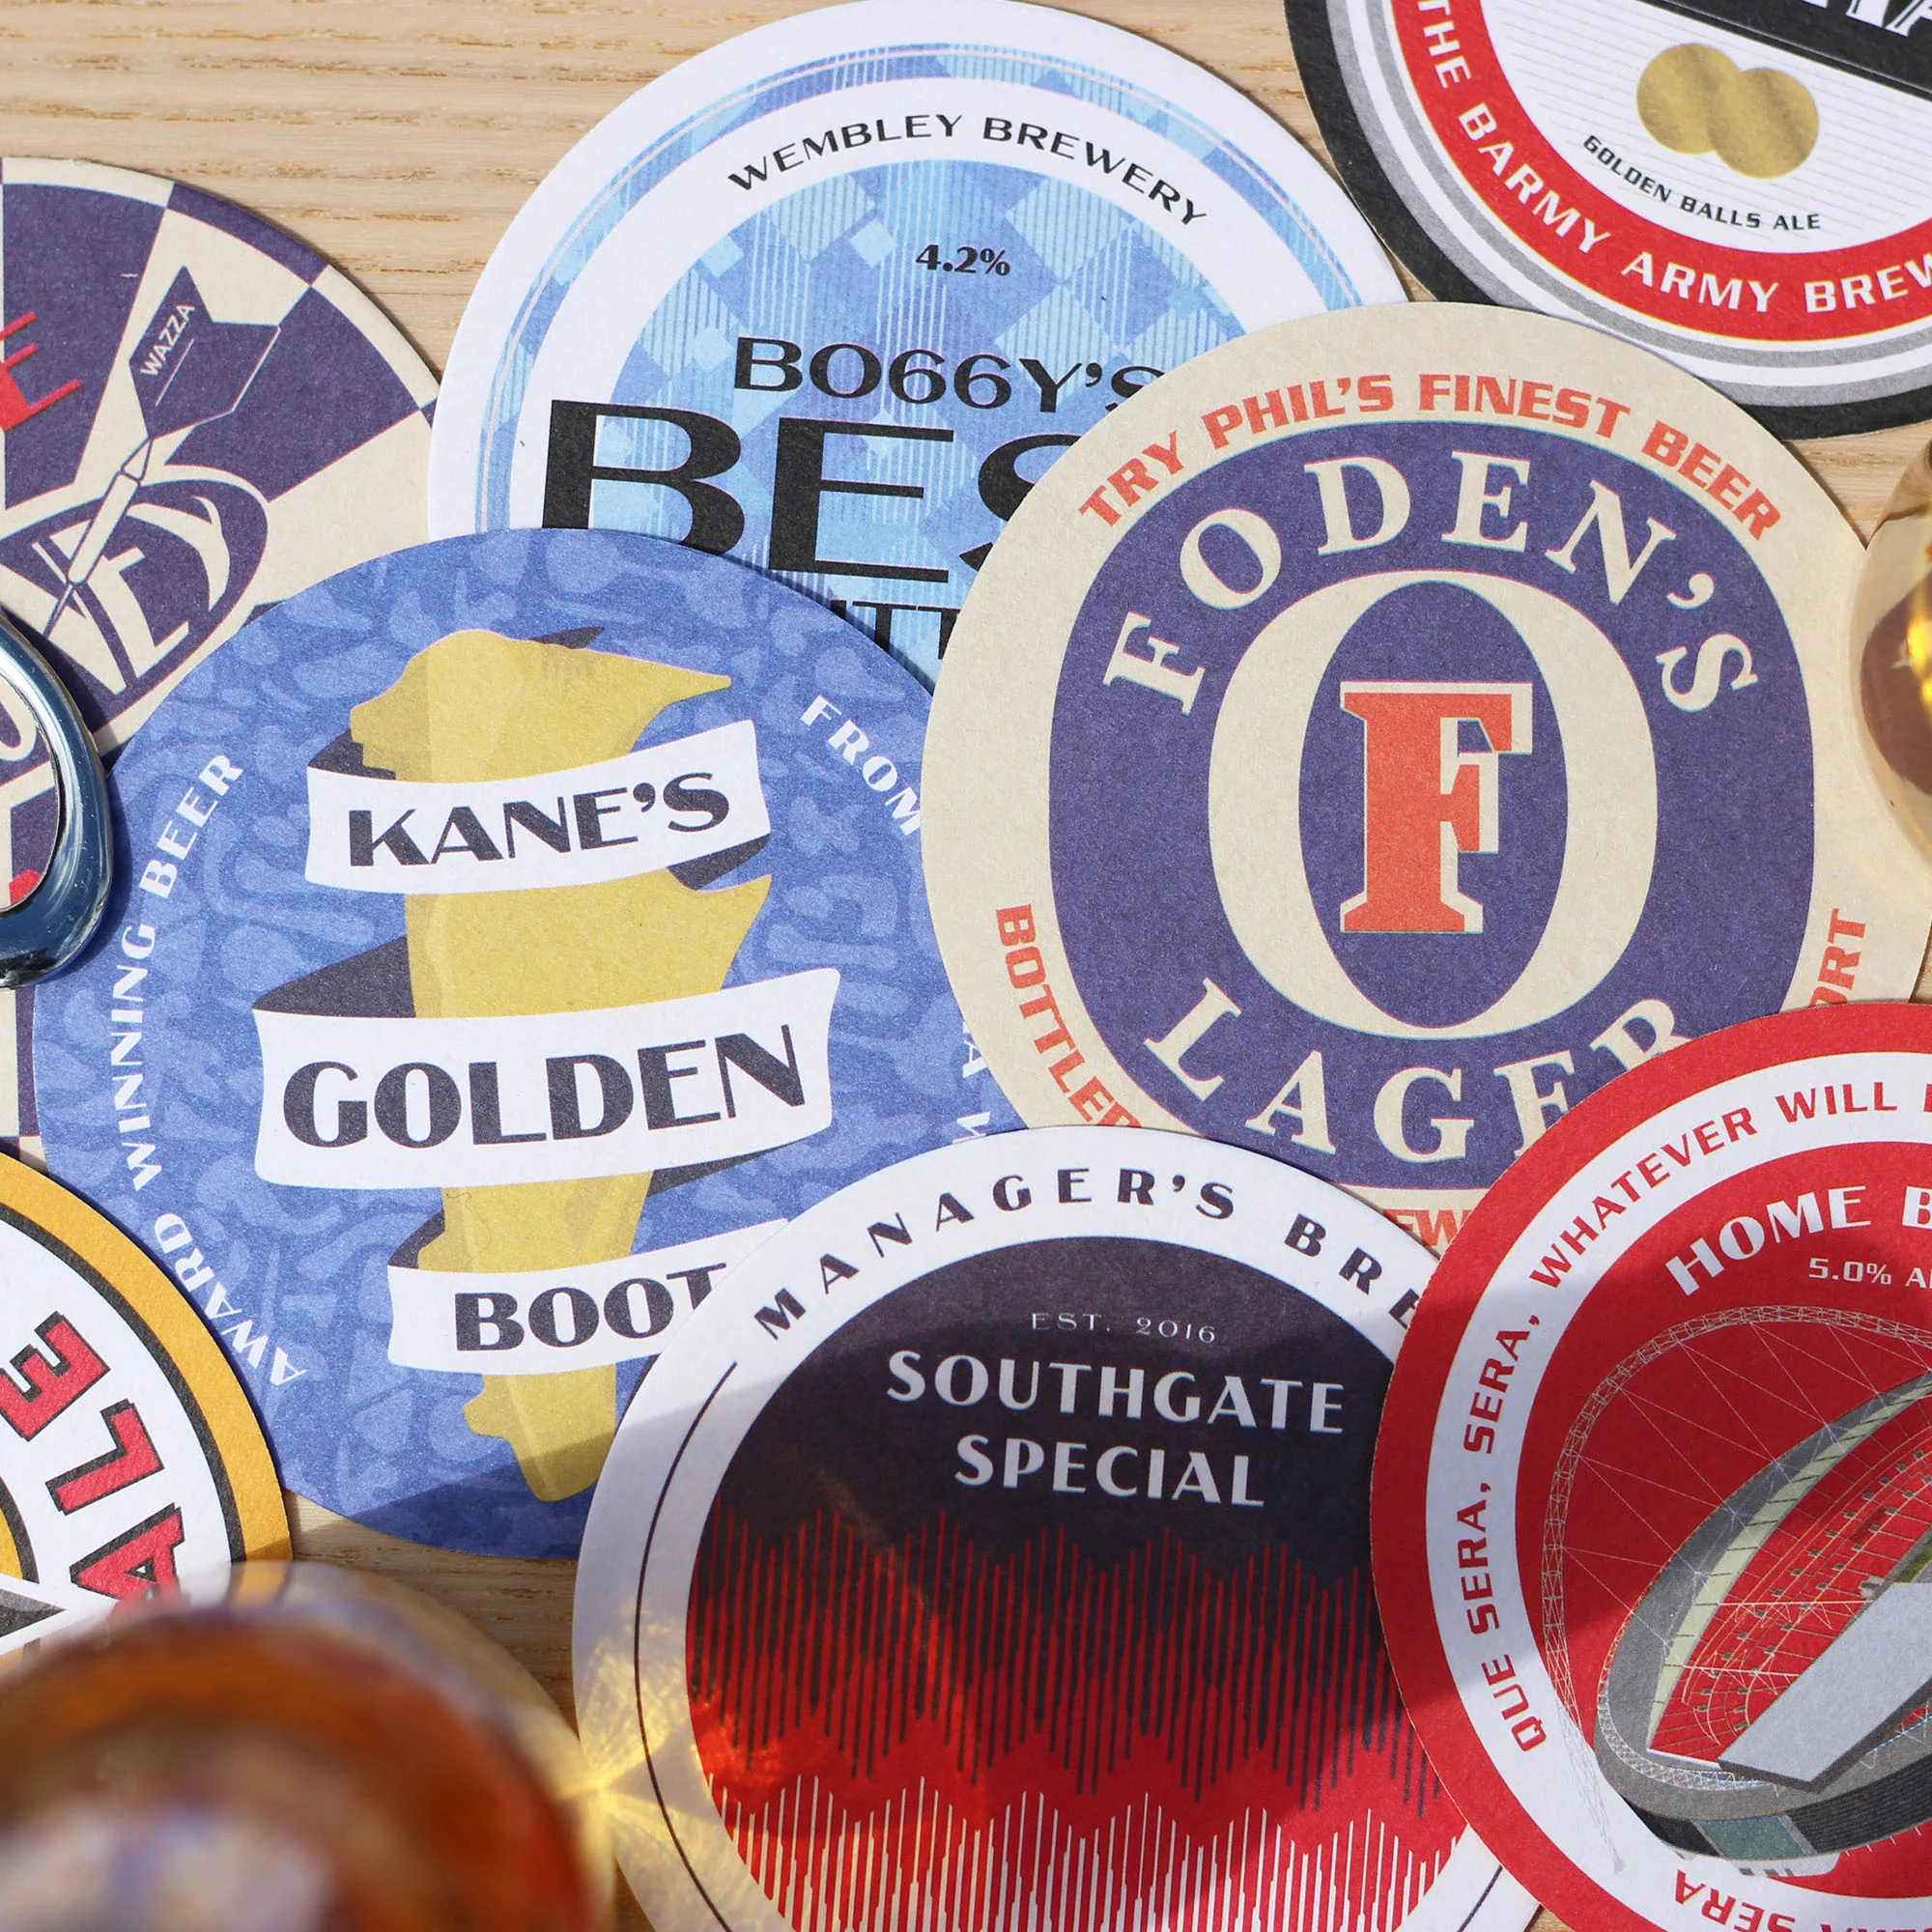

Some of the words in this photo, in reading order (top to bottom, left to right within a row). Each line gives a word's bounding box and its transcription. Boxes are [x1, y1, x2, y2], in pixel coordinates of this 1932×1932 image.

[727, 114, 963, 191] WEMBLEY
[982, 117, 1207, 225] BREWERY
[1458, 102, 1611, 253] BARMY
[1621, 251, 1778, 314] ARMY
[1582, 134, 1671, 203] GOLDEN
[1679, 195, 1760, 229] BALLS
[1773, 213, 1821, 231] ALE
[916, 243, 1010, 276] 4.2%
[140, 304, 195, 377] WAZZA
[1078, 430, 1184, 527] TRY
[1201, 374, 1395, 449] PHIL'S
[1419, 374, 1631, 439] FINEST
[1641, 420, 1781, 541] BEER
[1102, 450, 1758, 716] FODEN'S
[349, 773, 730, 867] KANE'S
[800, 695, 922, 836] FROM
[138, 753, 243, 899] BEER
[111, 921, 162, 1192] WINNING
[283, 1023, 807, 1149] GOLDEN
[1143, 978, 1695, 1163] LAGER
[1775, 1082, 1897, 1123] WILL
[753, 1168, 1235, 1341] MANAGER'S
[1529, 1107, 1758, 1288] WHATEVER
[1665, 1185, 1871, 1296] HOME
[154, 1213, 308, 1385] AWARD
[454, 1263, 726, 1352] BOOT
[1032, 1313, 1111, 1332] EST.
[1136, 1318, 1216, 1344] 2016
[1808, 1258, 1891, 1285] 5.0%
[887, 1350, 1344, 1435] SOUTHGATE
[1463, 1314, 1541, 1455] SERA,
[954, 1435, 1264, 1507] SPECIAL
[1457, 1482, 1501, 1634] SERA,
[1481, 1653, 1547, 1753] QUE
